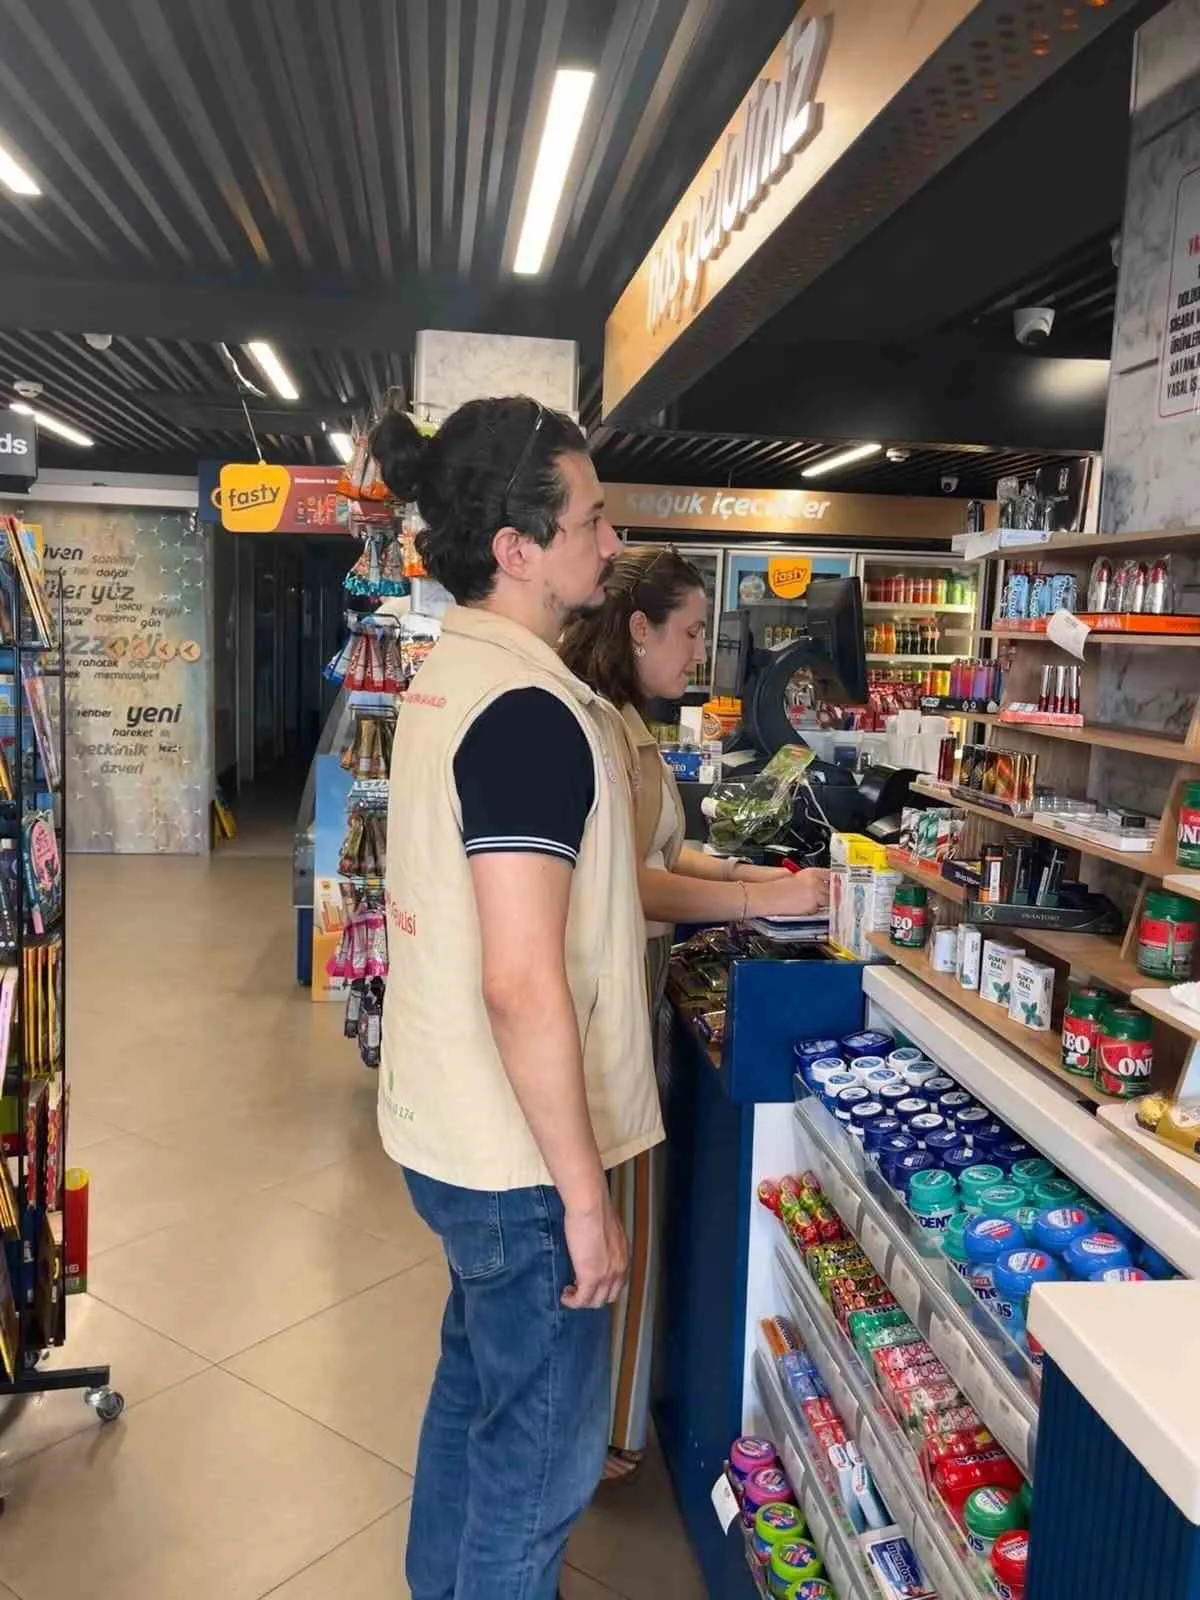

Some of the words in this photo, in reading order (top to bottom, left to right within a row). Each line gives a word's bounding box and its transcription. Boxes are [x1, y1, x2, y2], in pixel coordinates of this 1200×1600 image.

[228, 484, 281, 507] fasty
[126, 703, 183, 727] yeni
[886, 1541, 915, 1586] mentos
